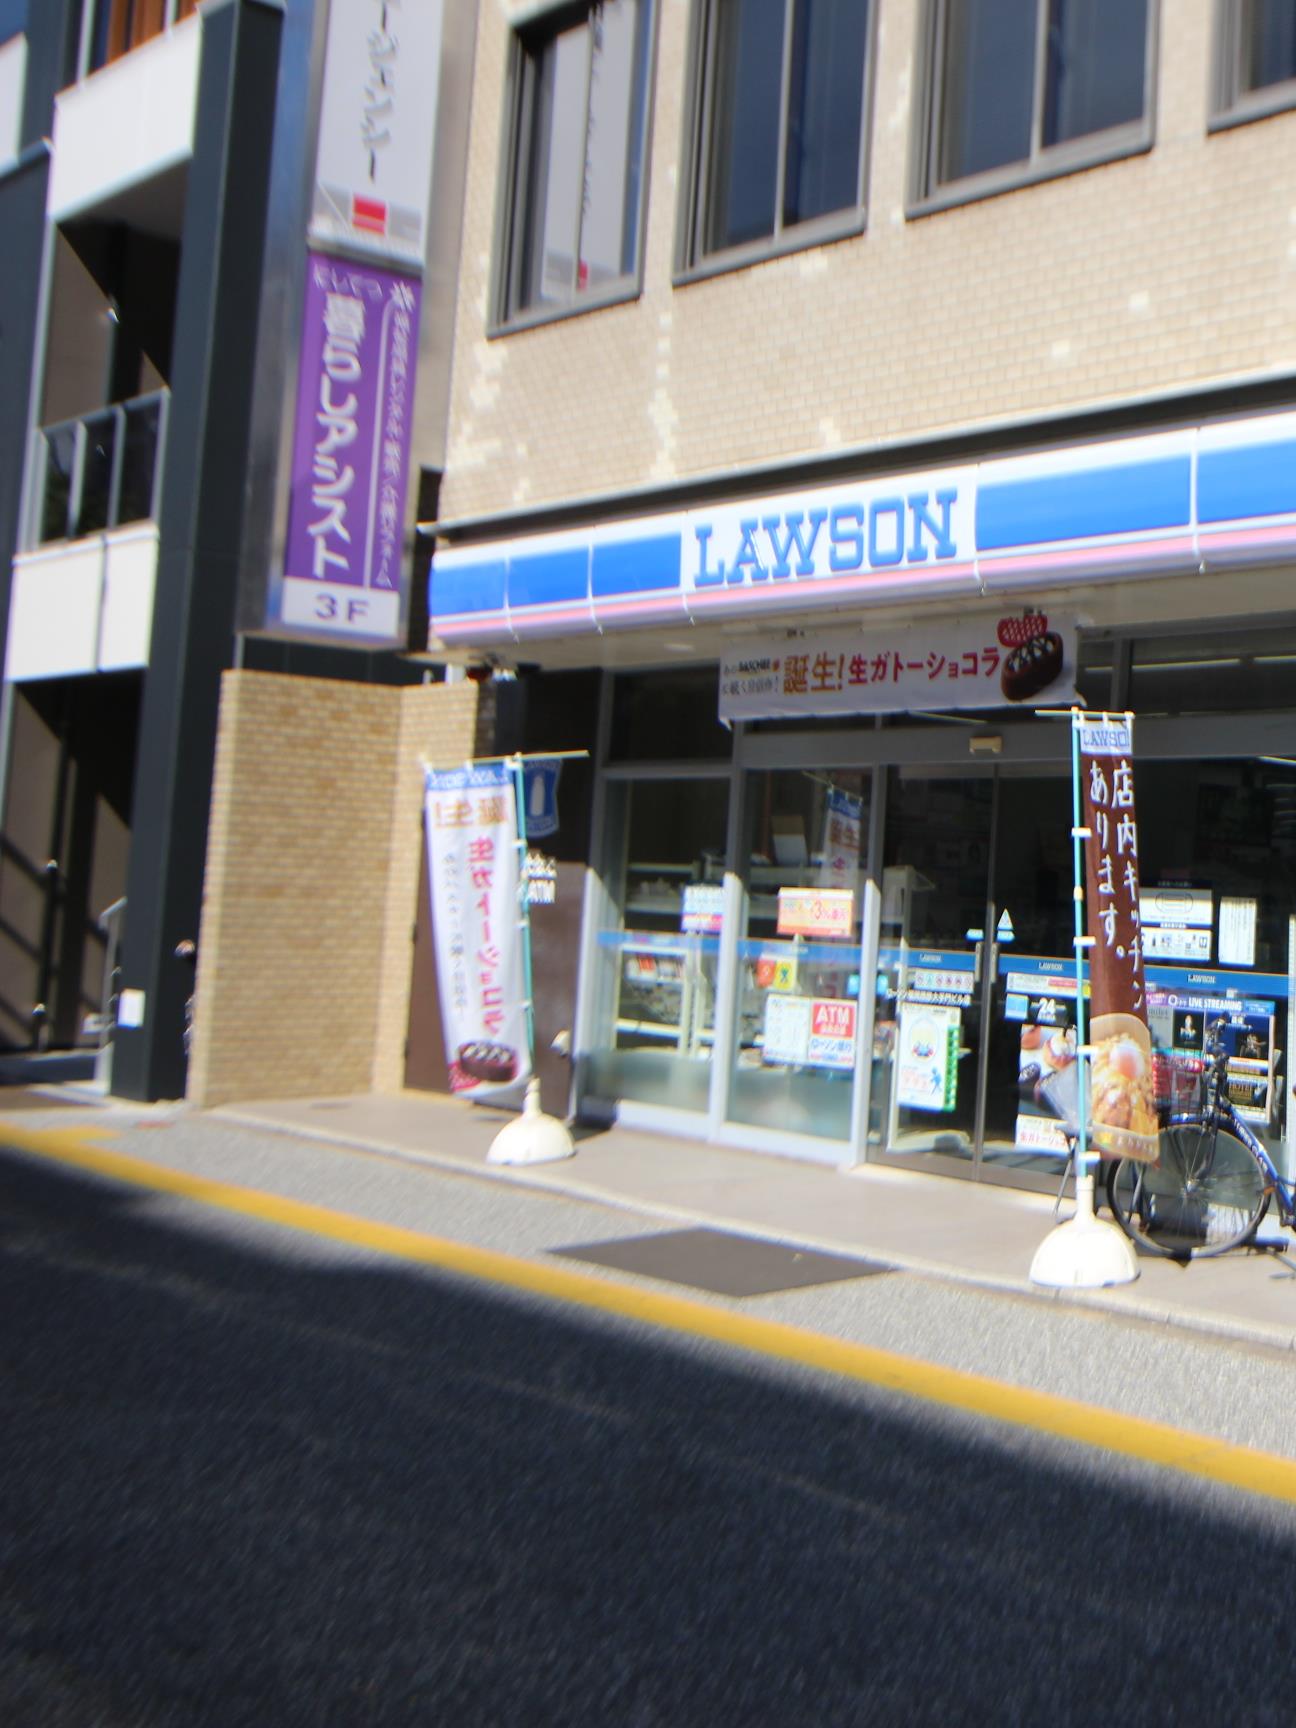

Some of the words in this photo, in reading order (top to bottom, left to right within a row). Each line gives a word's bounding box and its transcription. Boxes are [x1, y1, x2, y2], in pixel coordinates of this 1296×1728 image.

[693, 489, 958, 587] LAWSON
[315, 594, 368, 622] 3F
[848, 646, 1000, 686] 生ガトーショコラ
[816, 1005, 849, 1024] ATM
